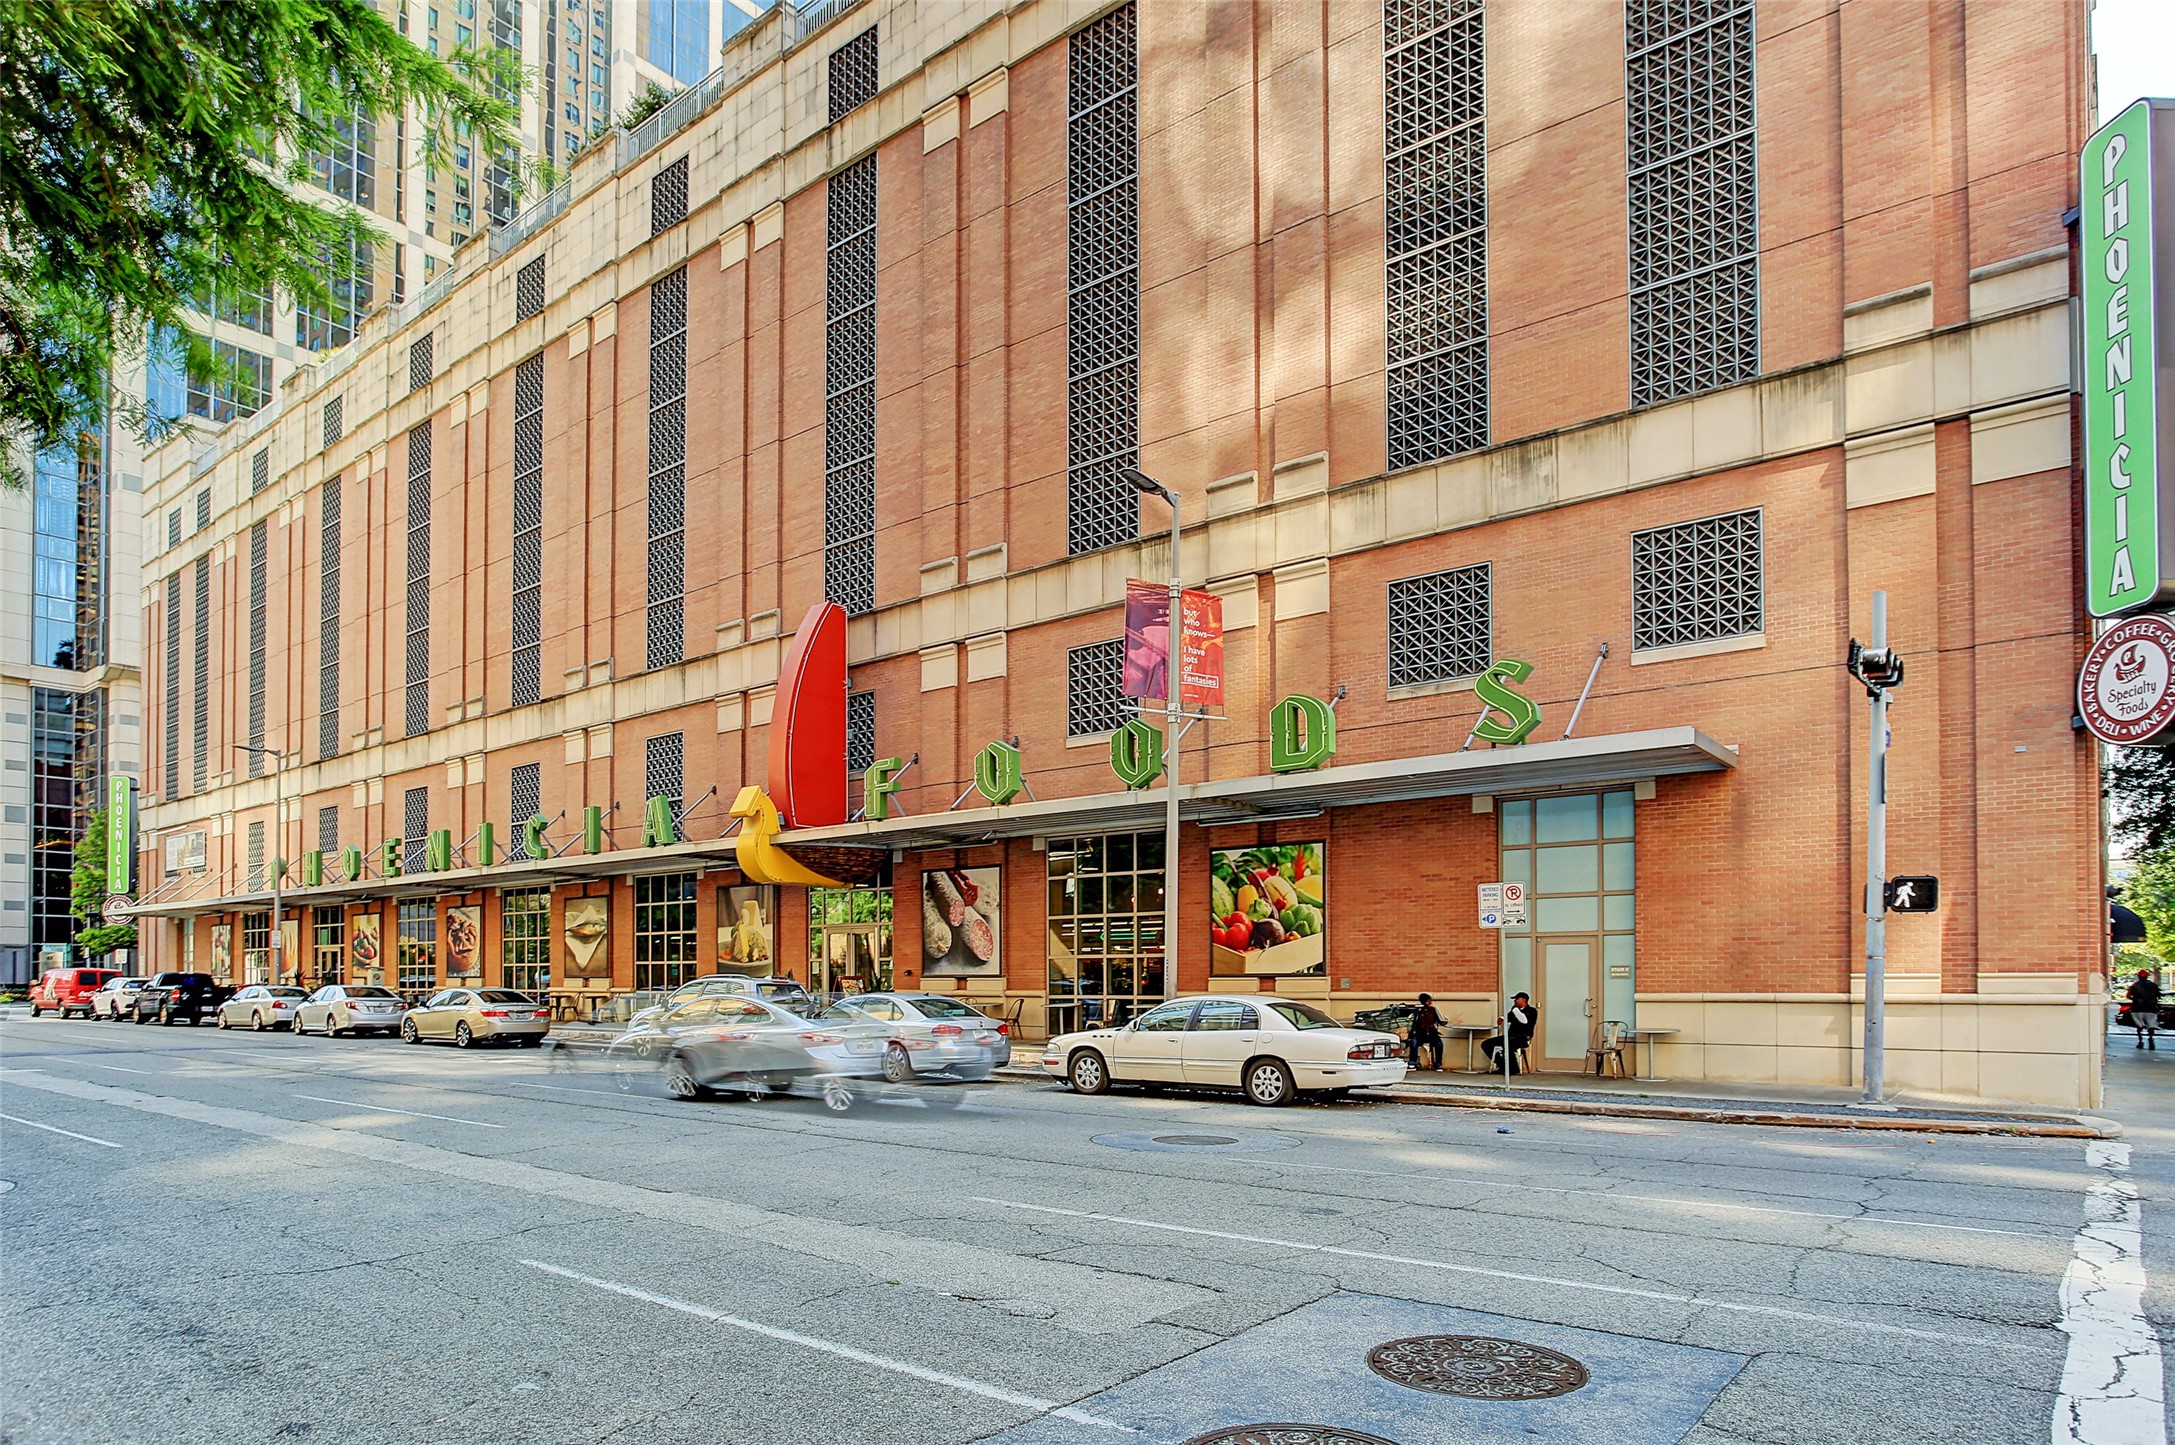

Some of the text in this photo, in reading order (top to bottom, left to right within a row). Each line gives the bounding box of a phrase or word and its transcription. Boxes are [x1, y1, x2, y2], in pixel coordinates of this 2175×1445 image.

[2102, 134, 2134, 598] PHOENICIA
[1183, 607, 1197, 617] but
[1183, 618, 1200, 627] who
[2105, 623, 2158, 650] COFFEE
[1183, 654, 1199, 664] lots
[1188, 646, 1206, 656] have
[1183, 665, 1193, 673] of
[1183, 674, 1217, 687] fantasies
[2084, 653, 2103, 714] BAKERY
[2107, 680, 2157, 703] Specialty
[2116, 697, 2149, 716] Foods
[2095, 715, 2120, 736] DELI
[2128, 709, 2164, 735] WINE
[864, 659, 1542, 821] FOODS
[114, 780, 124, 890] PHOENICIA
[271, 794, 676, 890] PHOENICIA
